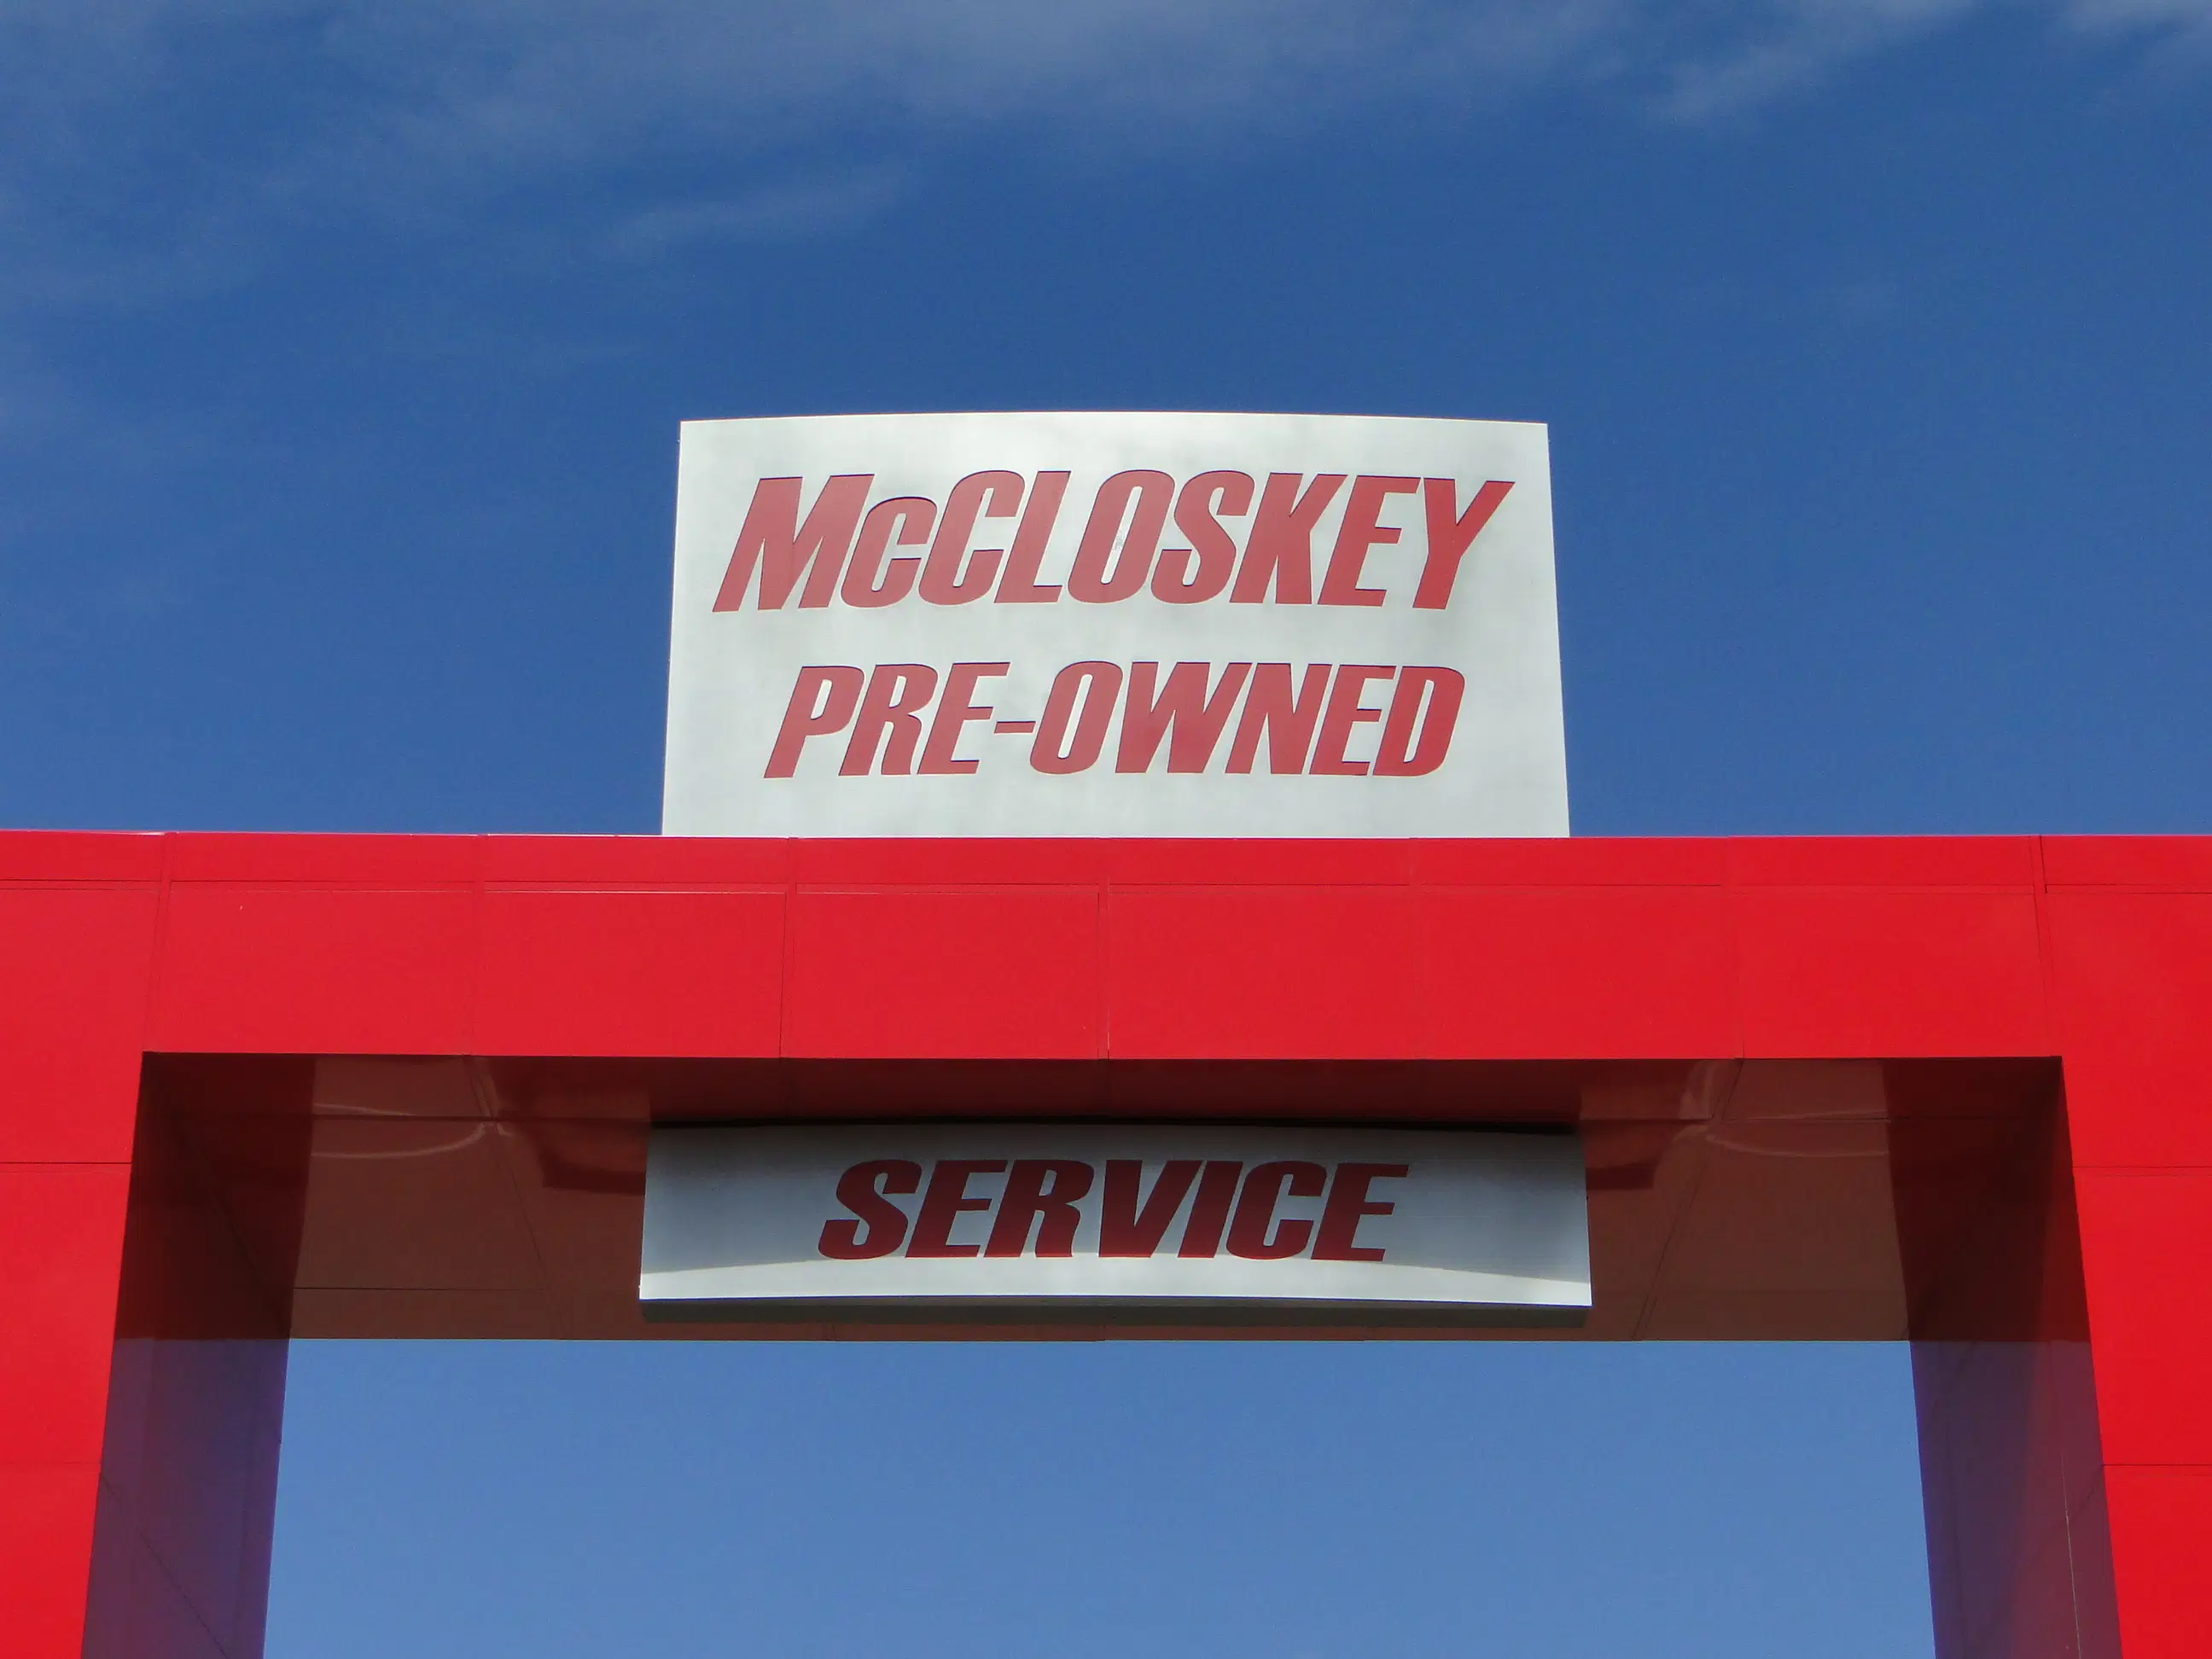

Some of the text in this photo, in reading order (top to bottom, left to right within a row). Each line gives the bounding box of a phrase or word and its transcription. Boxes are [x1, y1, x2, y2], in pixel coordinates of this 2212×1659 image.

[713, 469, 1514, 612] McCLOSKEY
[764, 661, 1465, 778] PRE-OWNED
[819, 1158, 1409, 1261] SERVICE
